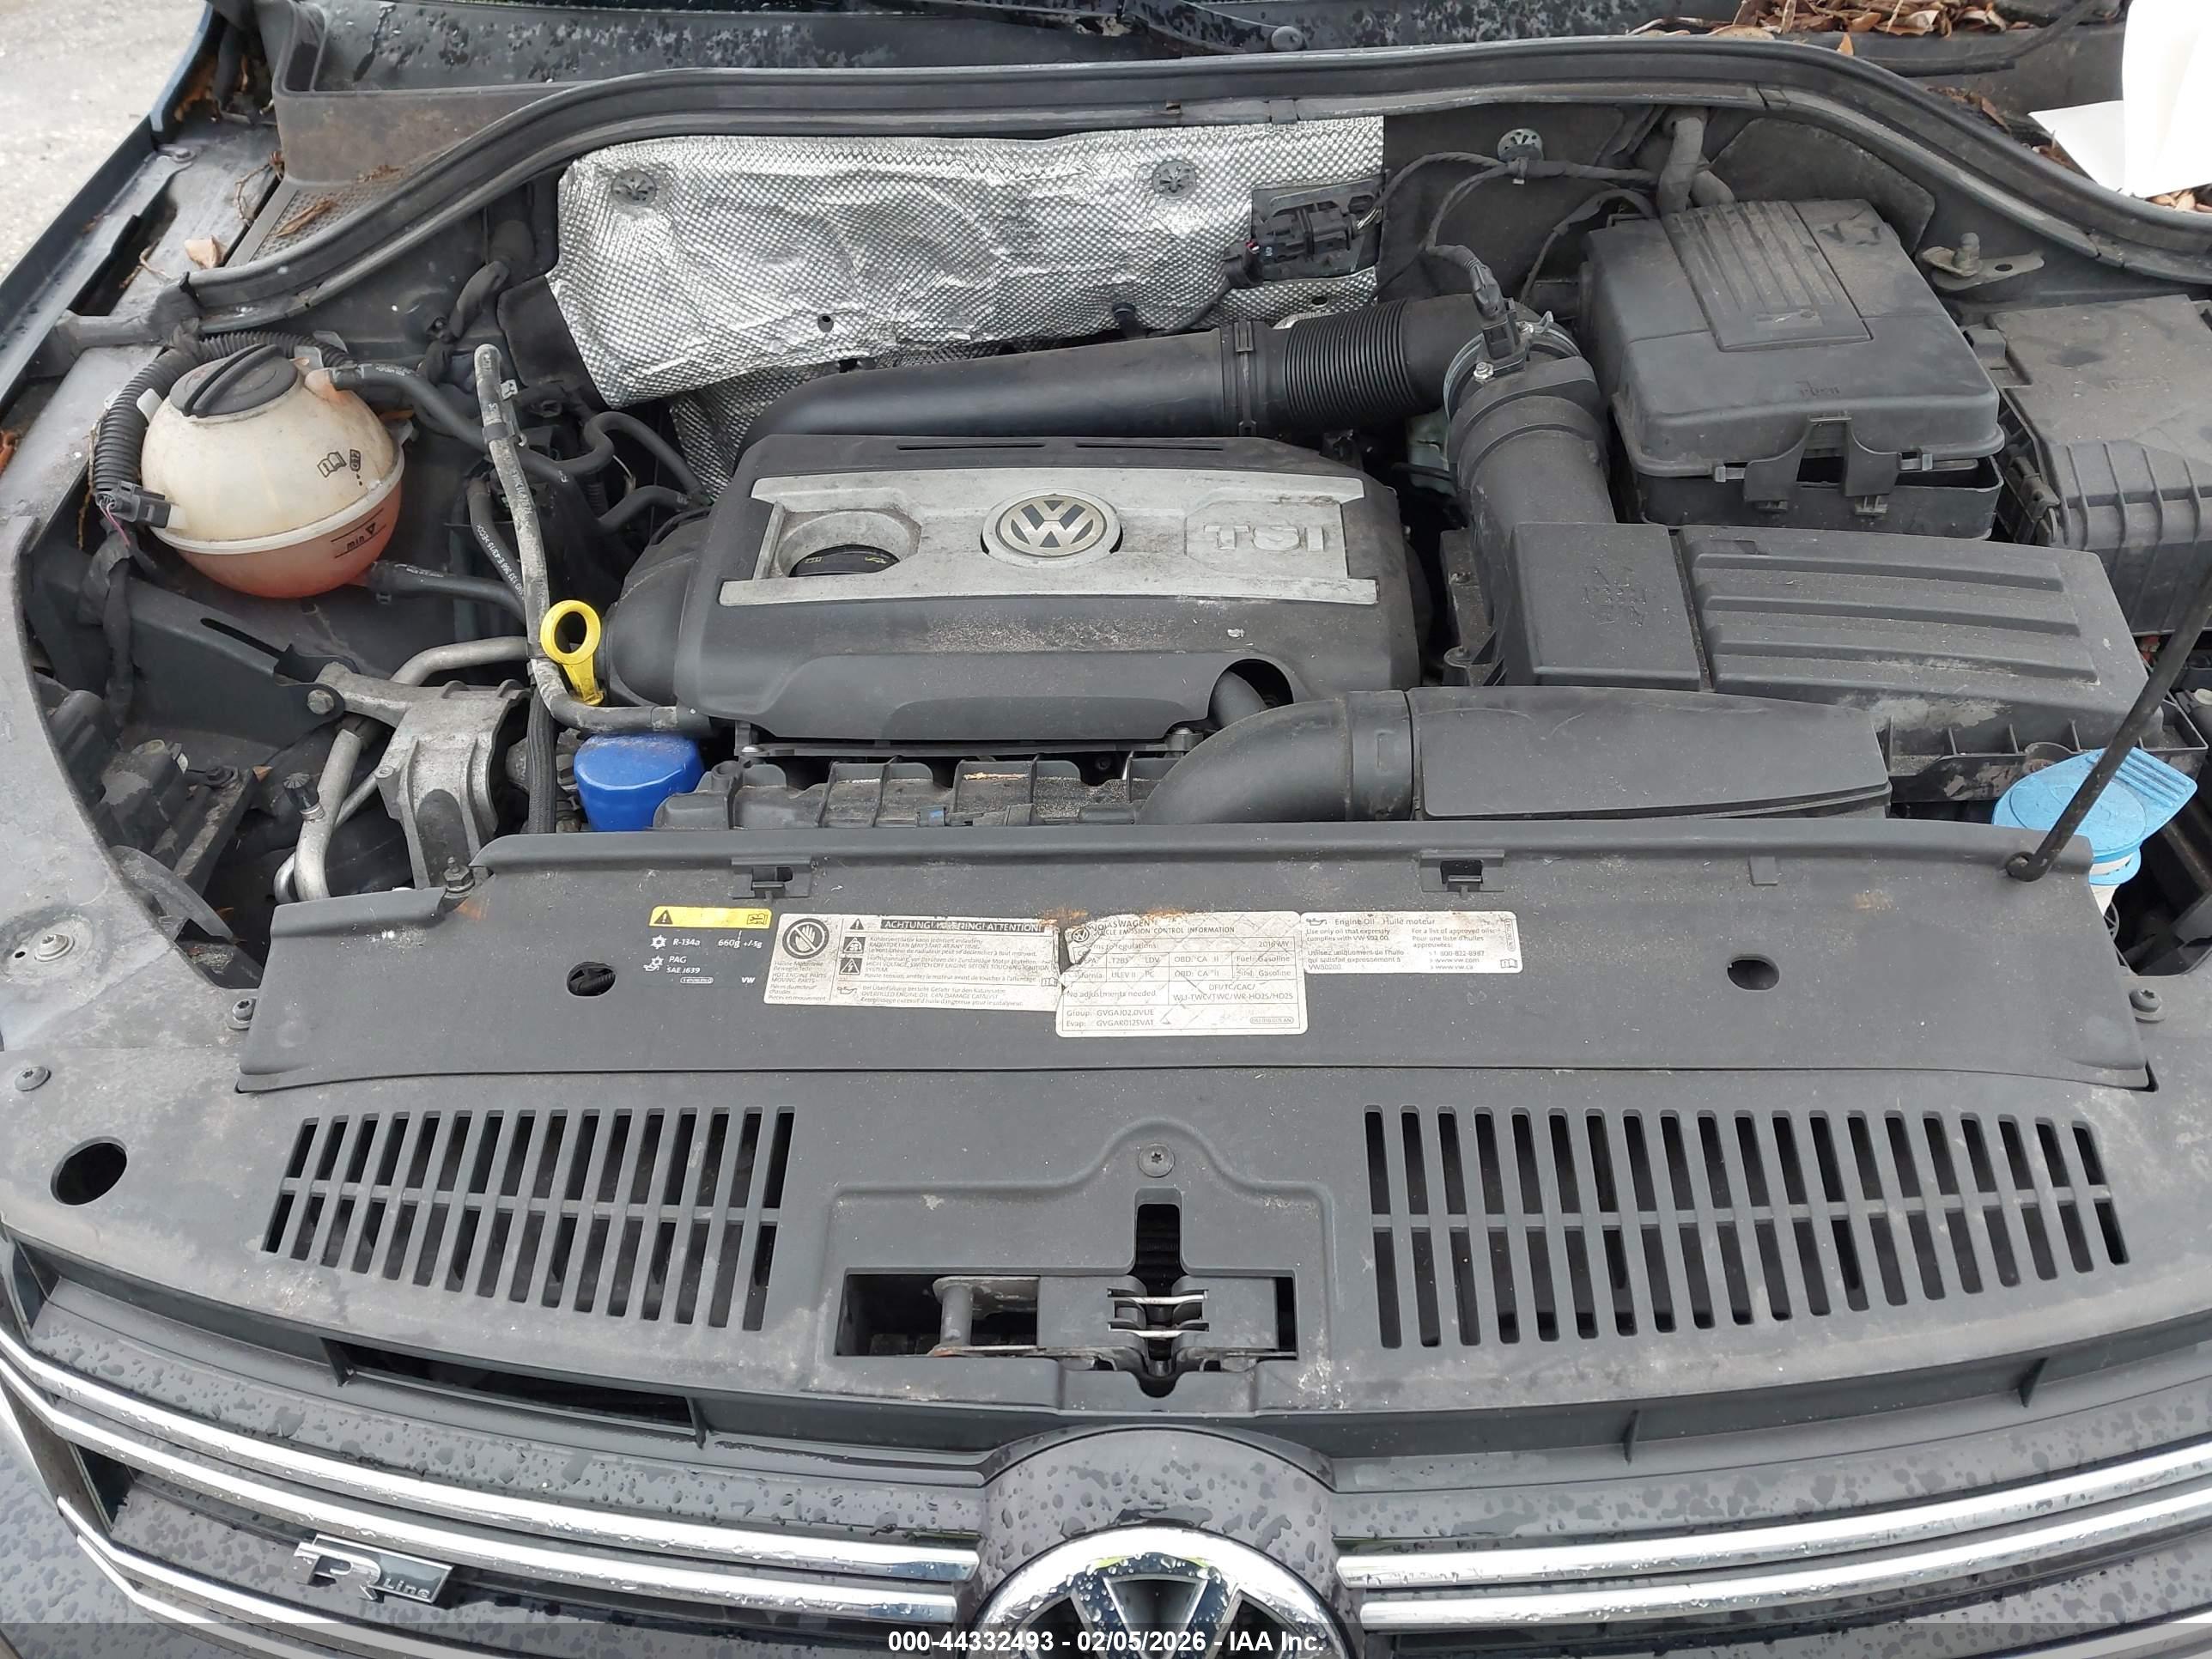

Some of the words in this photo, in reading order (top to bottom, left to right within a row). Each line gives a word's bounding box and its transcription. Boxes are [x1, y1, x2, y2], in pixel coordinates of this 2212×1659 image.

[347, 535, 365, 550] min
[1204, 524, 1325, 552] TSI
[884, 921, 933, 929] ACHTUNG!
[935, 922, 984, 931] WNING!
[988, 923, 1041, 933] ATTENTION!
[718, 939, 740, 948] 660g
[1078, 990, 1126, 999] adjustments
[294, 1540, 380, 1601] R
[383, 1578, 430, 1599] Line
